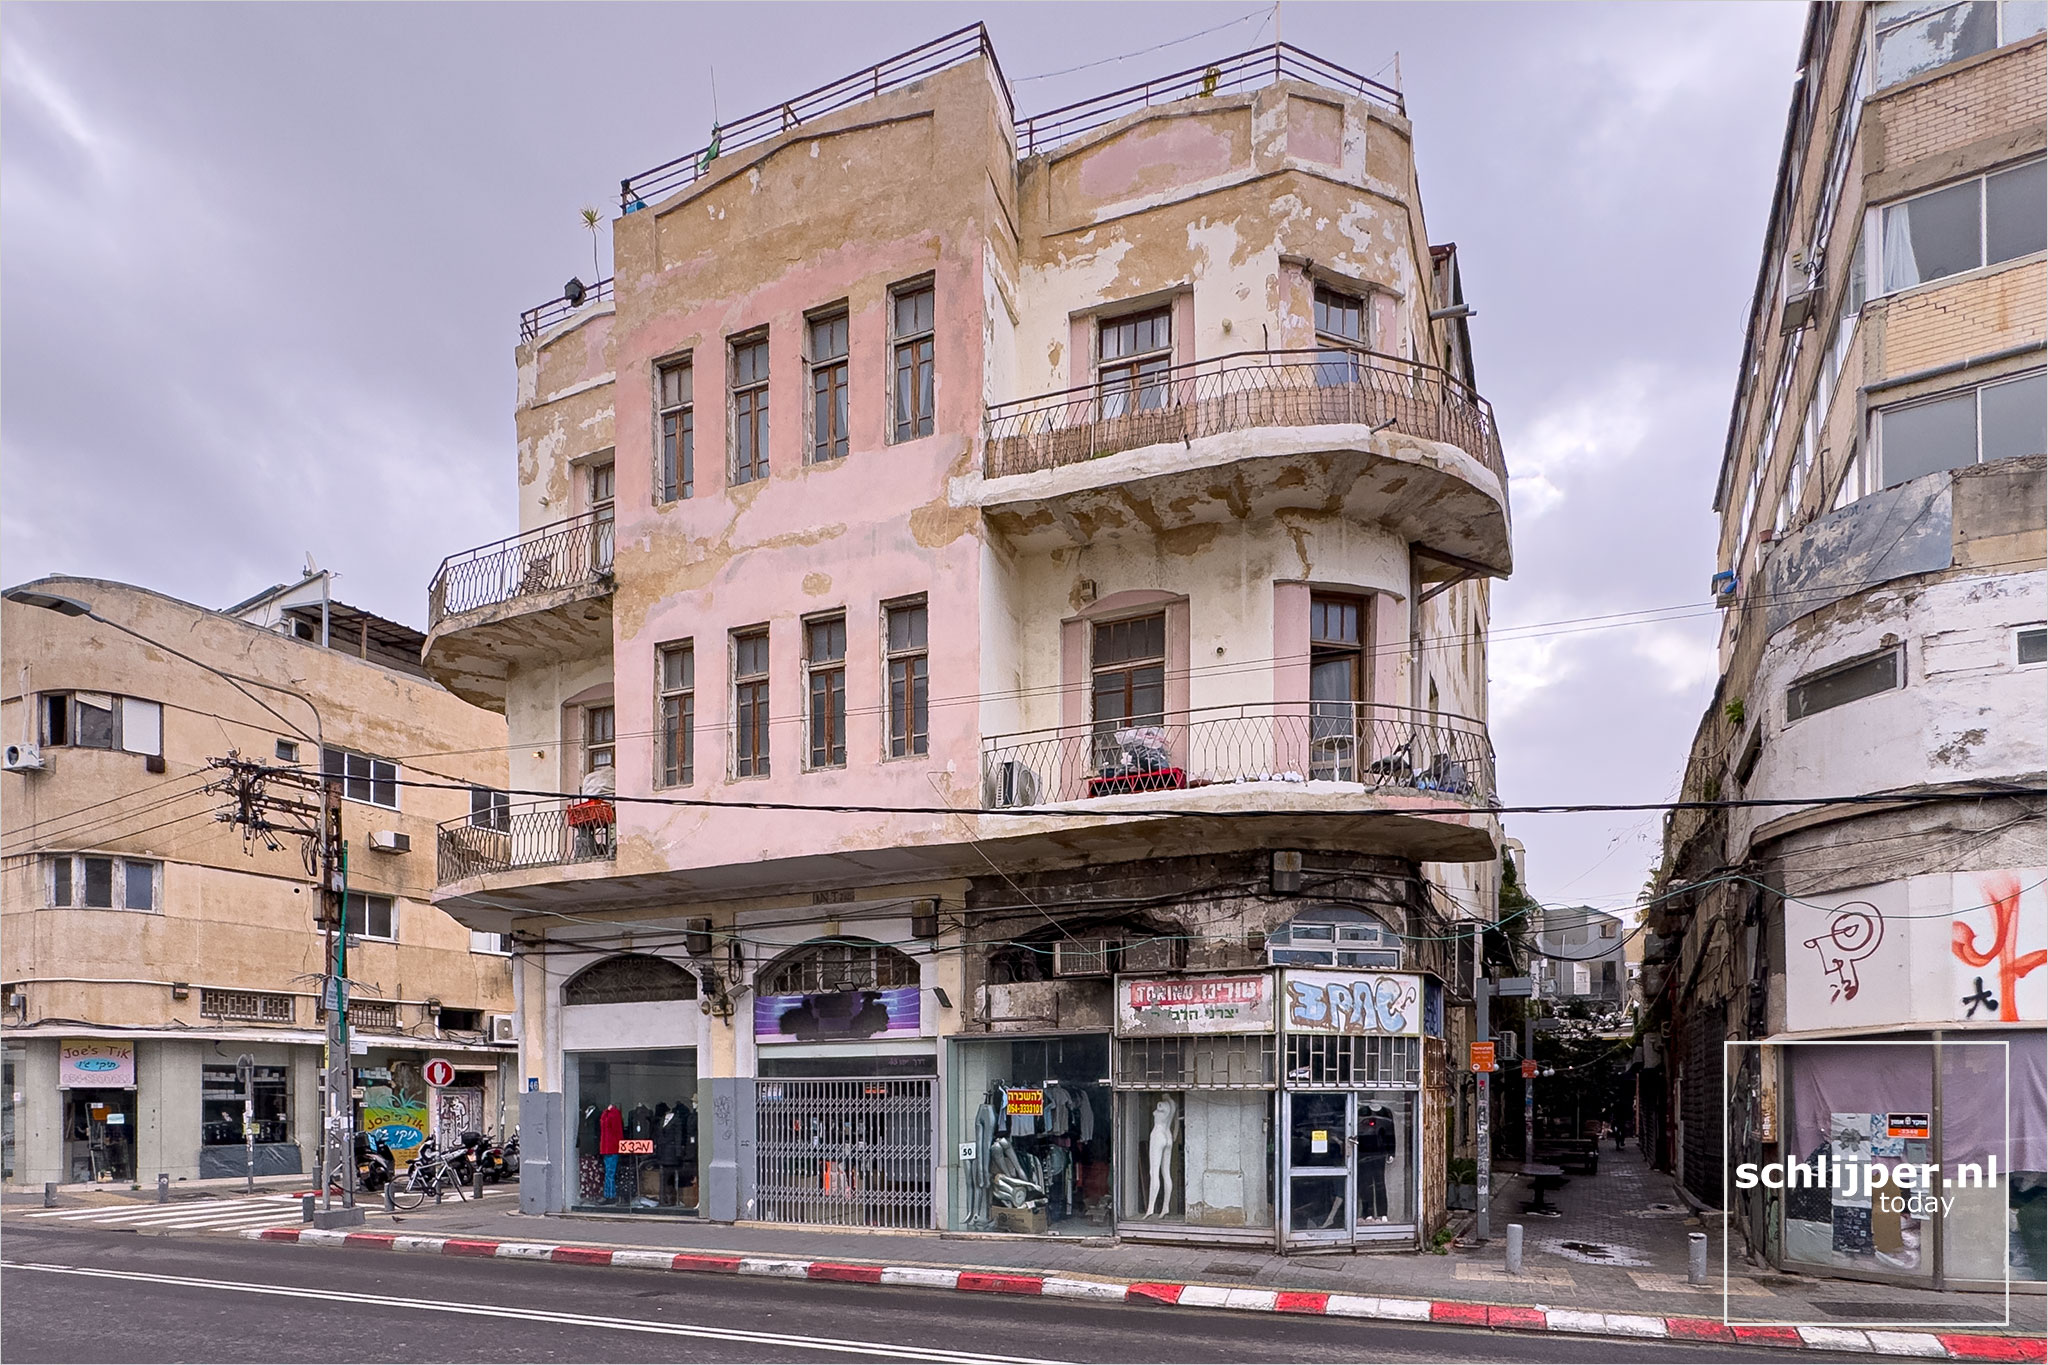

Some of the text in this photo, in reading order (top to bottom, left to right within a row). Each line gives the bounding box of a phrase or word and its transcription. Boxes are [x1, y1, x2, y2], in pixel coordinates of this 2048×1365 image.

[1201, 981, 1257, 1001] טורינו
[63, 1044, 99, 1059] Joe's
[529, 1080, 539, 1090] 46
[1008, 1089, 1042, 1101] להשכרה
[962, 1148, 973, 1156] 50
